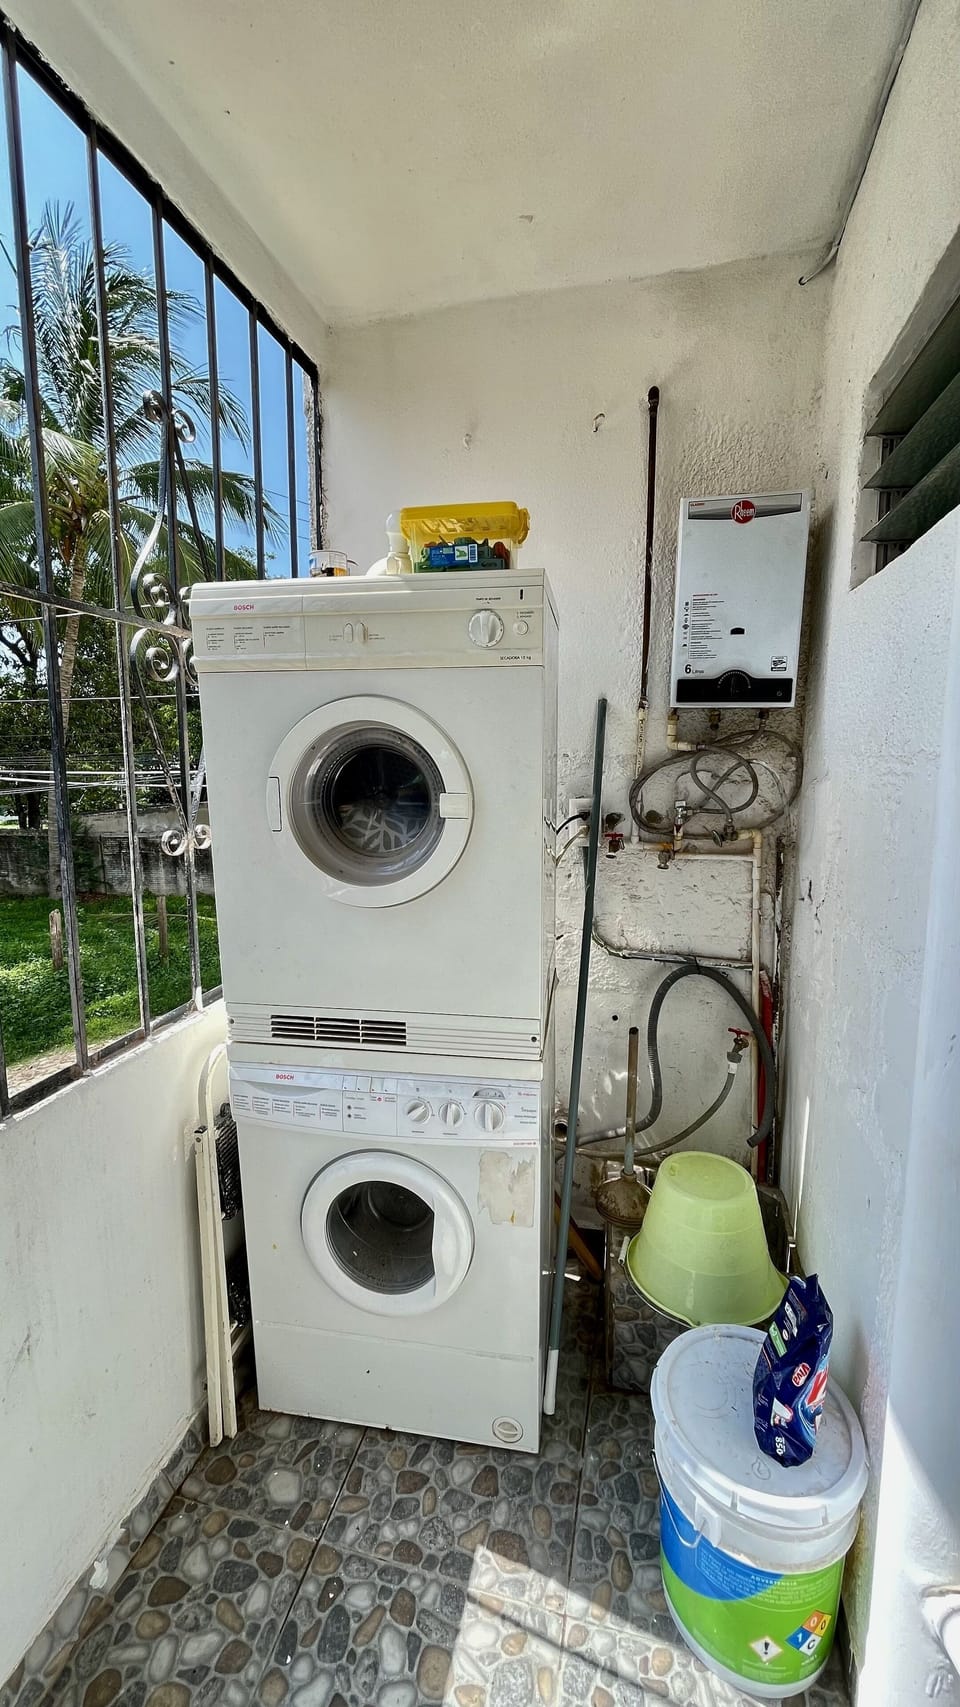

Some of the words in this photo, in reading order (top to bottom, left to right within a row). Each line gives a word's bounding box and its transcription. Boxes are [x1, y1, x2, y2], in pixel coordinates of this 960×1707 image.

[734, 501, 755, 520] Rheem
[685, 664, 692, 674] 6
[793, 1363, 810, 1386] Viva
[775, 1436, 784, 1456] 850
[811, 1616, 817, 1627] 0
[797, 1632, 802, 1642] 1
